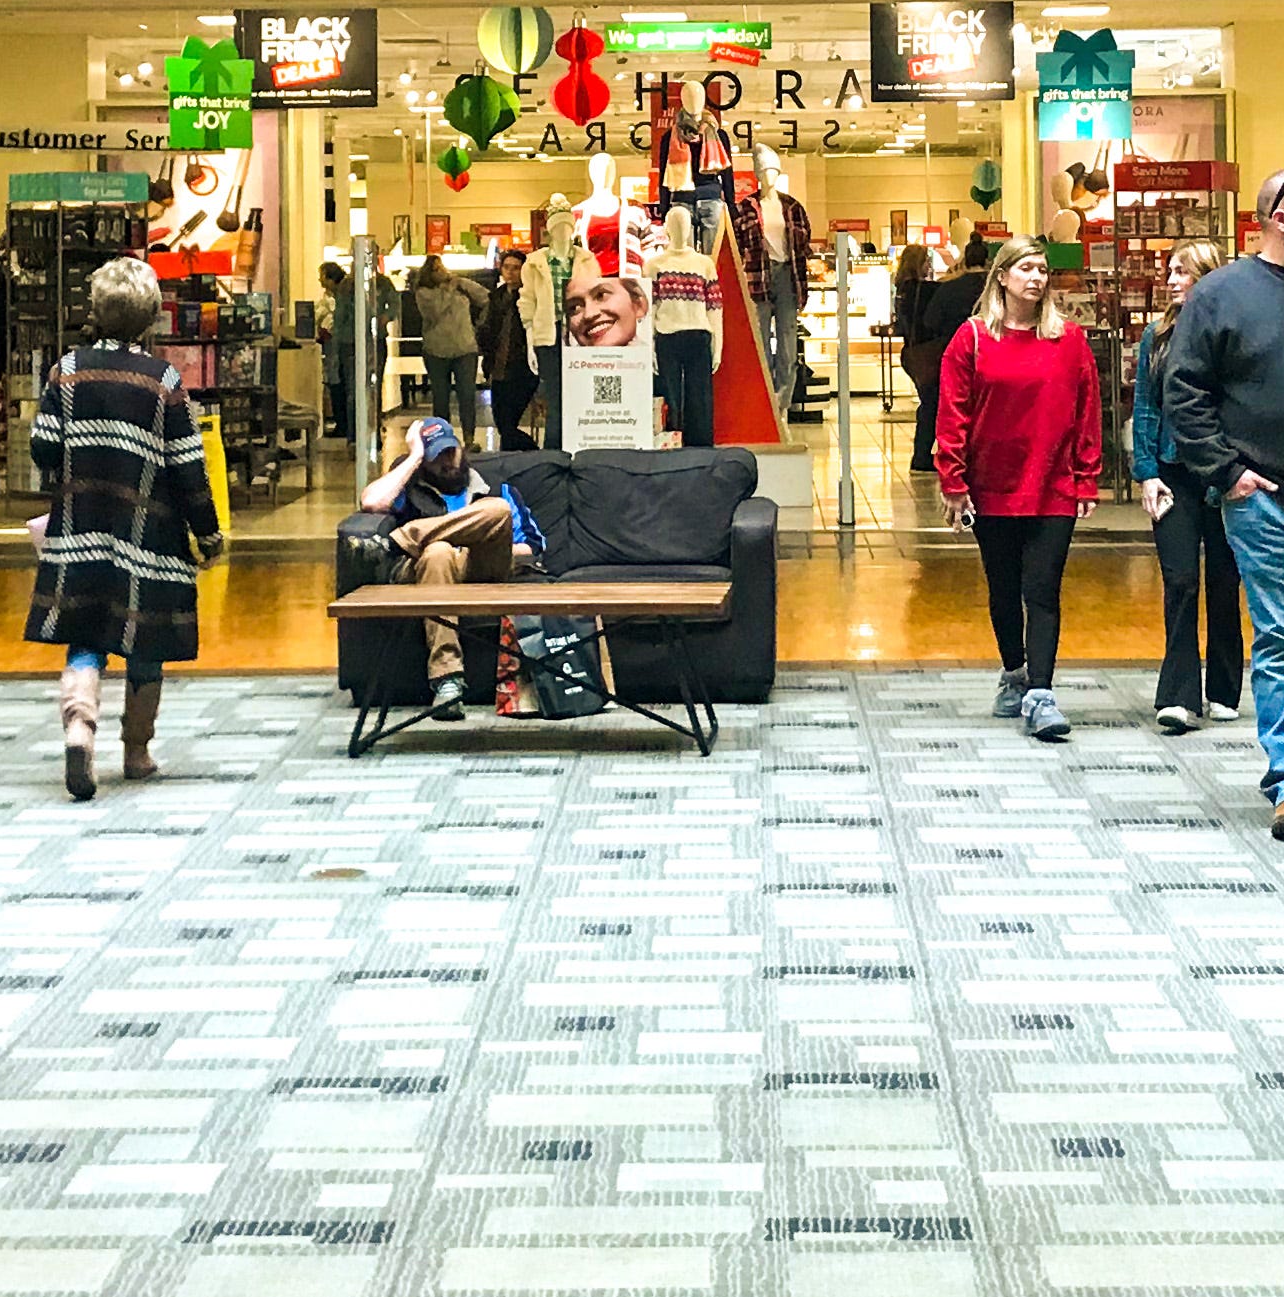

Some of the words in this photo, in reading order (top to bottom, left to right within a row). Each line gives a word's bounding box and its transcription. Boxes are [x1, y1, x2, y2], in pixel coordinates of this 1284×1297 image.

[261, 17, 351, 40] BLACK
[897, 10, 986, 33] BLACK
[608, 30, 634, 45] We
[897, 33, 986, 55] FRIDAY
[261, 40, 351, 63] FRIDAY
[455, 69, 868, 111] EHORA
[1043, 89, 1069, 103] gifts
[1071, 88, 1096, 100] that
[1098, 87, 1129, 102] bring
[173, 95, 197, 110] gifts
[199, 96, 222, 108] that
[223, 96, 250, 111] bring
[192, 110, 232, 129] JOY
[125, 128, 170, 151] Ser
